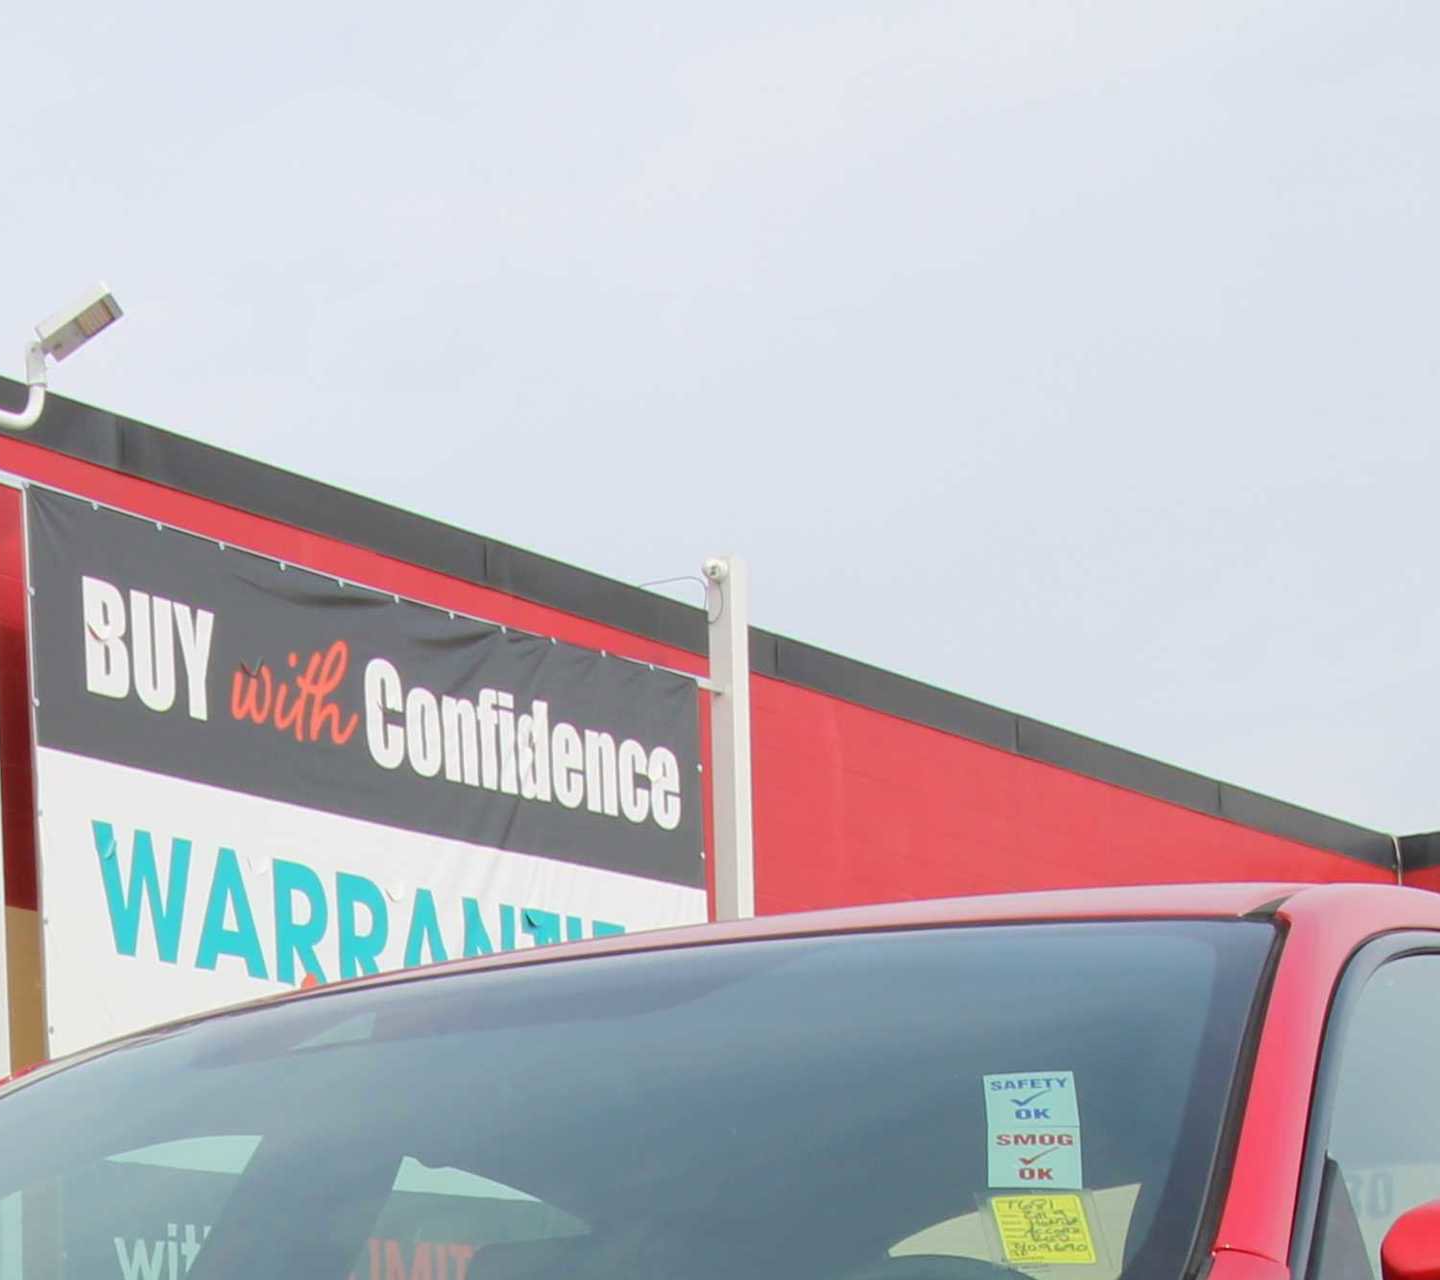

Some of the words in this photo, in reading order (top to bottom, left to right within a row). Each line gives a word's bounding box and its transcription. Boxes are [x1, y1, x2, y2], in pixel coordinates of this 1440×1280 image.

[82, 576, 214, 721] BUY
[231, 640, 358, 744] with
[364, 657, 682, 830] Confidence
[991, 1078, 1067, 1091] SAFETY
[1015, 1109, 1051, 1119] OK
[996, 1134, 1073, 1145] SMOG
[1019, 1168, 1054, 1180] OK
